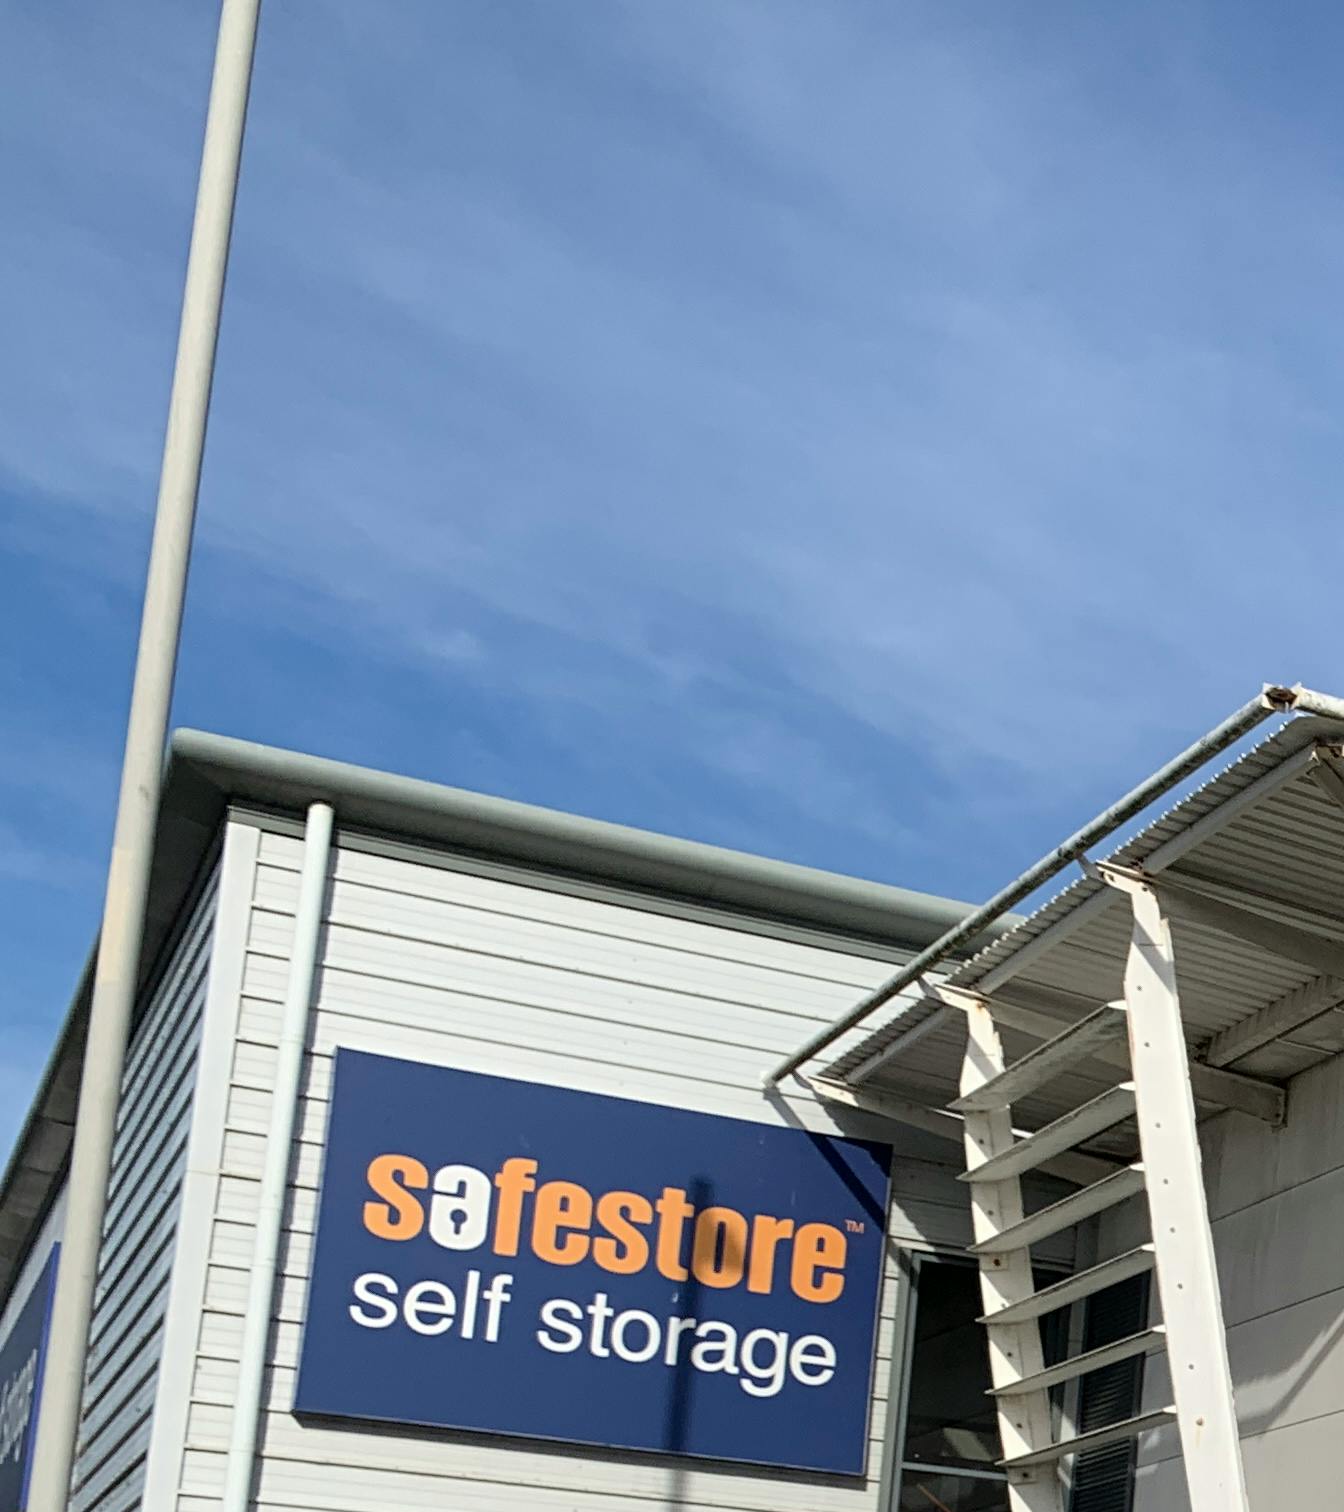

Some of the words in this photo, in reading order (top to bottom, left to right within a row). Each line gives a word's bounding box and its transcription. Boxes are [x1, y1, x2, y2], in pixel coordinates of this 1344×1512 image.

[363, 1154, 848, 1304] safestore
[349, 1270, 514, 1343] self
[537, 1293, 837, 1398] storage
